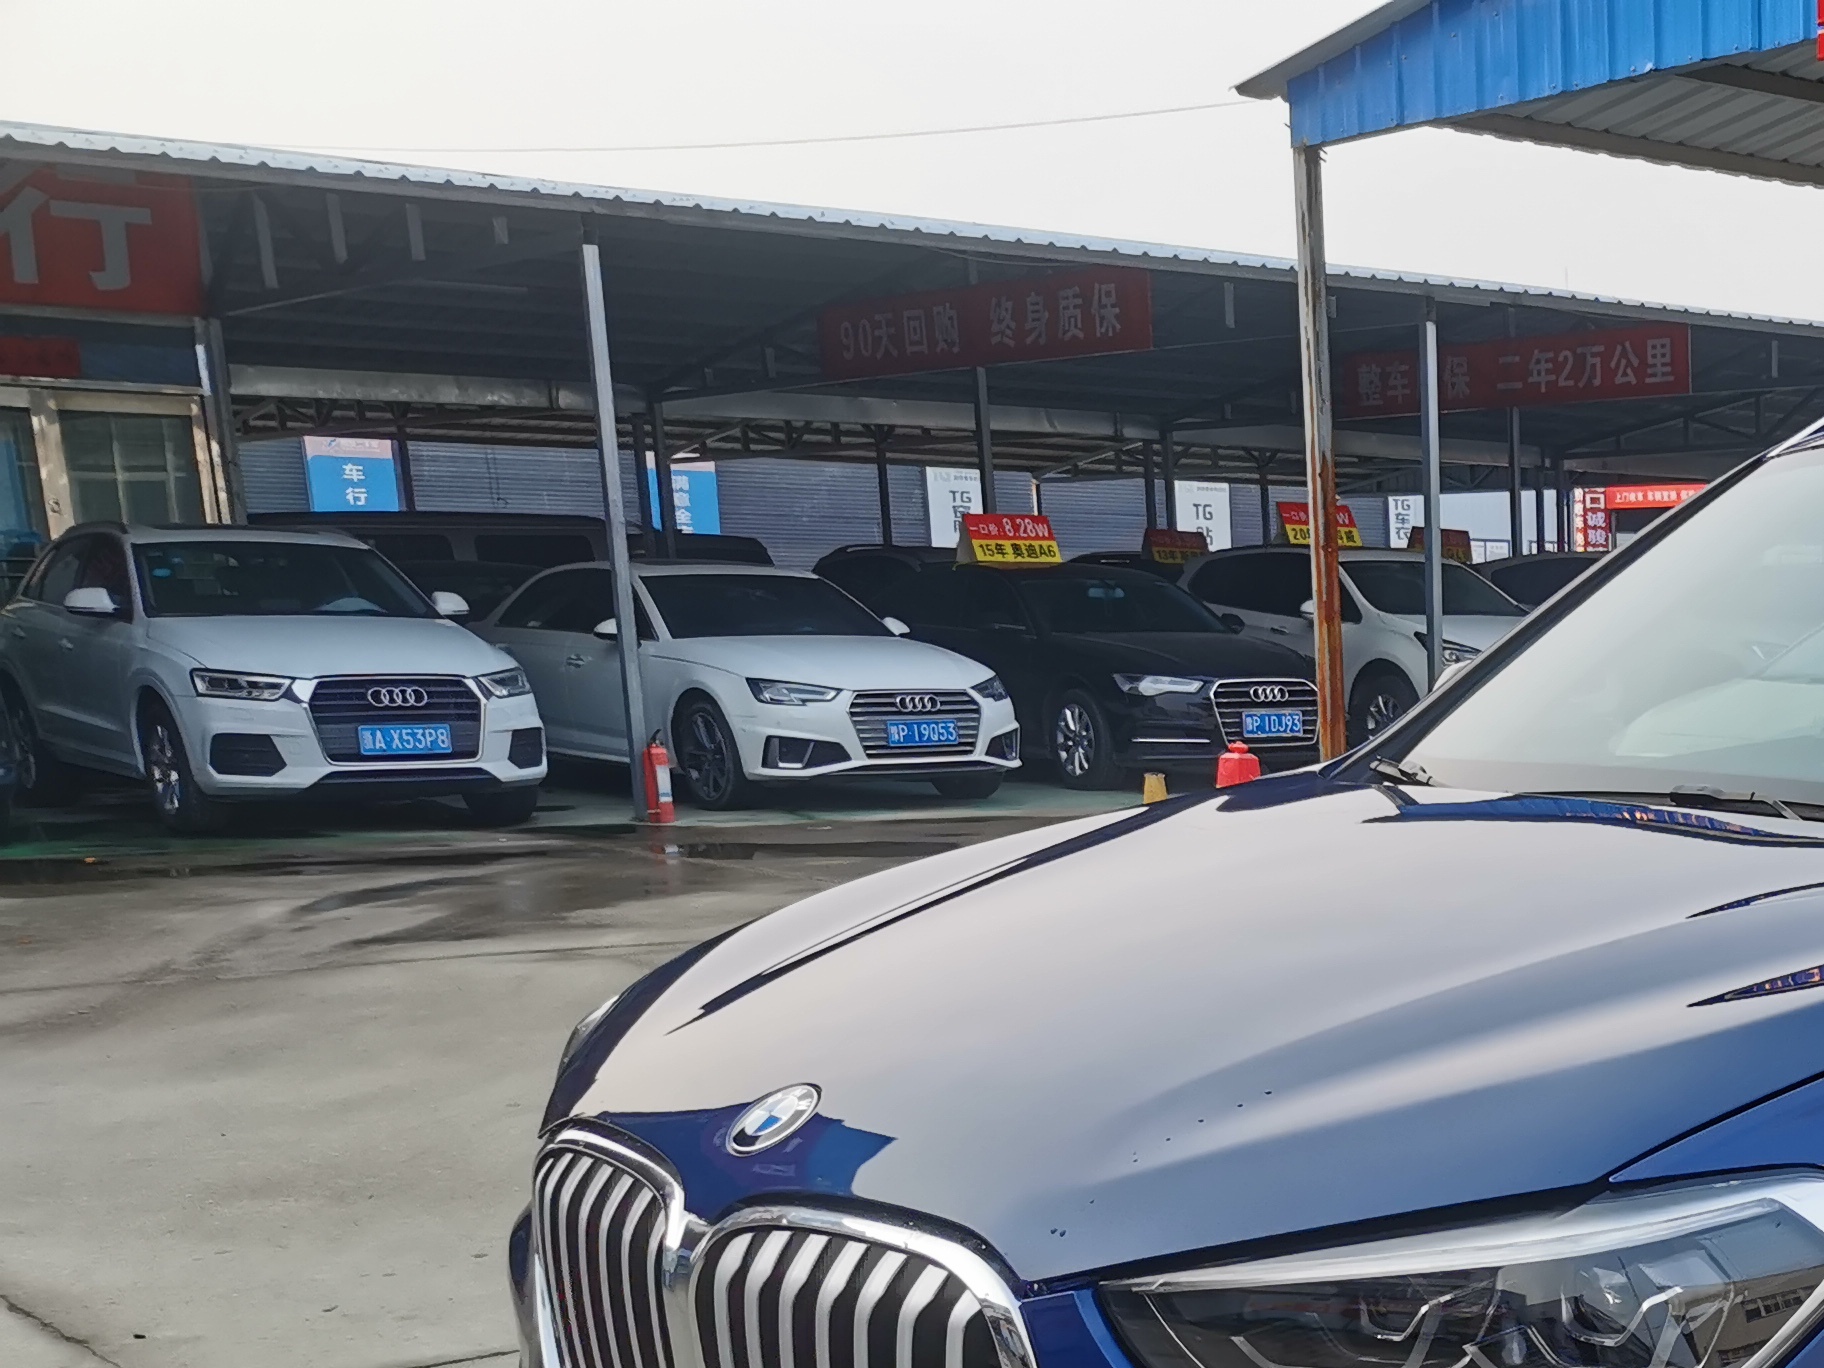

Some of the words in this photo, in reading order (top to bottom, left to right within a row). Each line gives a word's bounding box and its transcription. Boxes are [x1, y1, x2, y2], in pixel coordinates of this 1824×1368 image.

[840, 303, 960, 360] 90天回购
[989, 282, 1121, 347] 终身质保
[1357, 355, 1470, 406] 整车保
[1497, 337, 1675, 393] 二年2万公里
[342, 462, 368, 506] 车行
[1192, 503, 1214, 520] TG
[979, 543, 1009, 558] 15年
[1010, 542, 1057, 559] 奥迪A6
